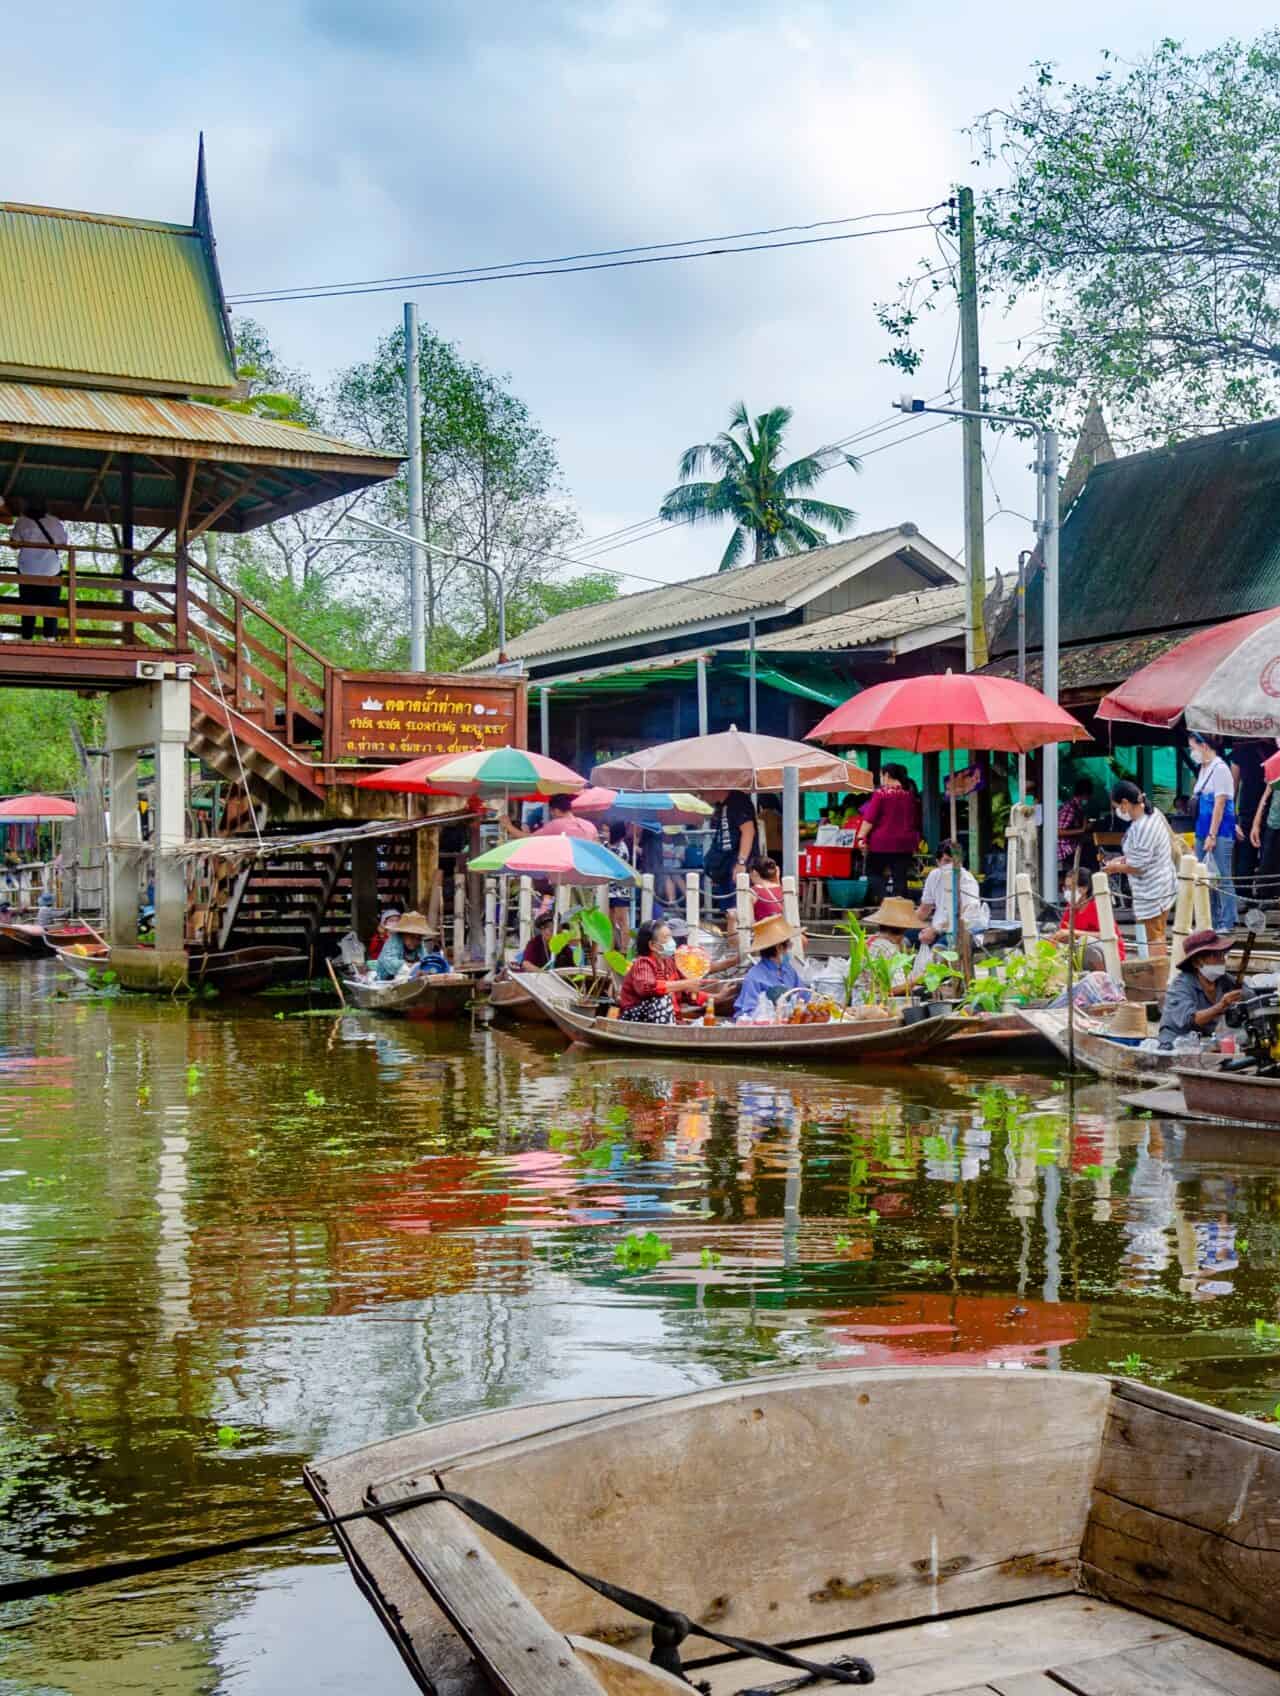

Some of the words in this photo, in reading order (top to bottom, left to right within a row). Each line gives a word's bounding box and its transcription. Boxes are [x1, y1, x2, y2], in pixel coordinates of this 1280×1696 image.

[385, 689, 472, 716] ตลาดน้ำท่าคา
[349, 717, 373, 730] THA
[376, 719, 401, 731] KHA
[405, 719, 456, 735] FLOATING
[460, 722, 508, 740] MARKET
